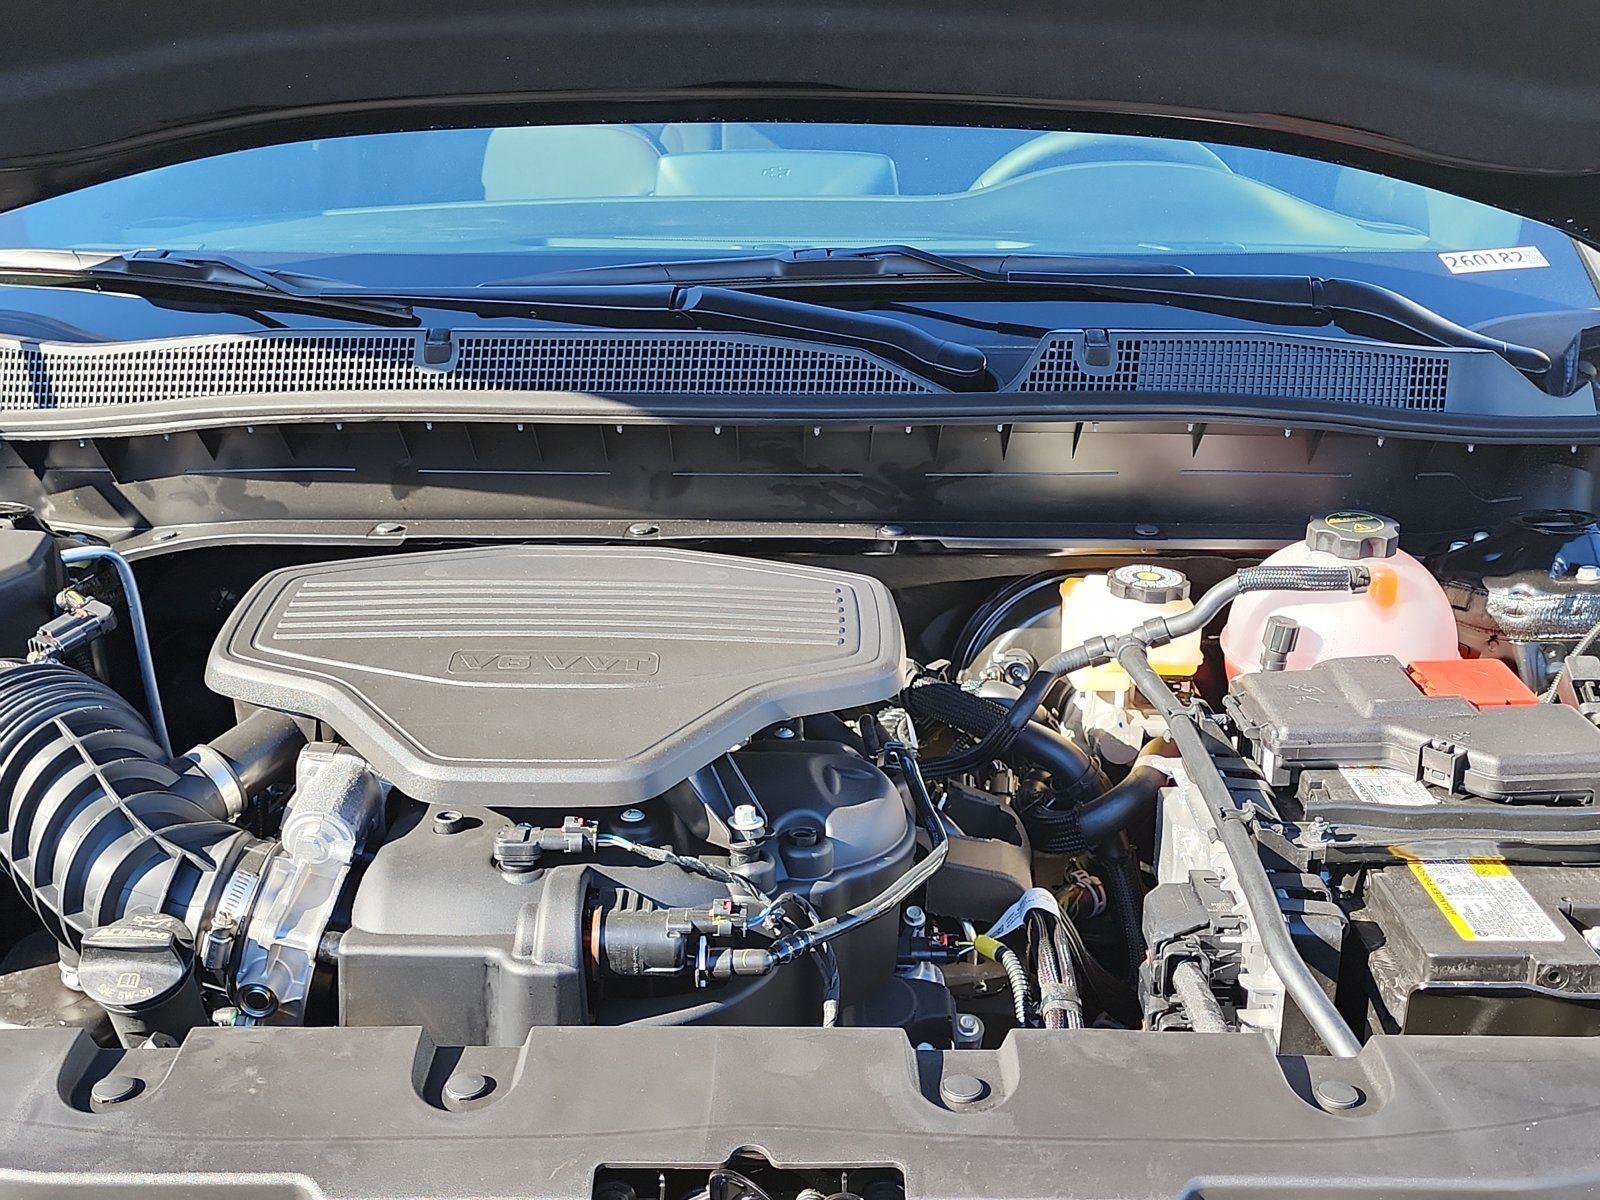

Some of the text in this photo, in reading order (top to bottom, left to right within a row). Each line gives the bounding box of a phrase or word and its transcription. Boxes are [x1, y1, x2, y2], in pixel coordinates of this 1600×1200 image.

[459, 654, 652, 671] V6 VVT
[93, 928, 170, 939] ACDelco
